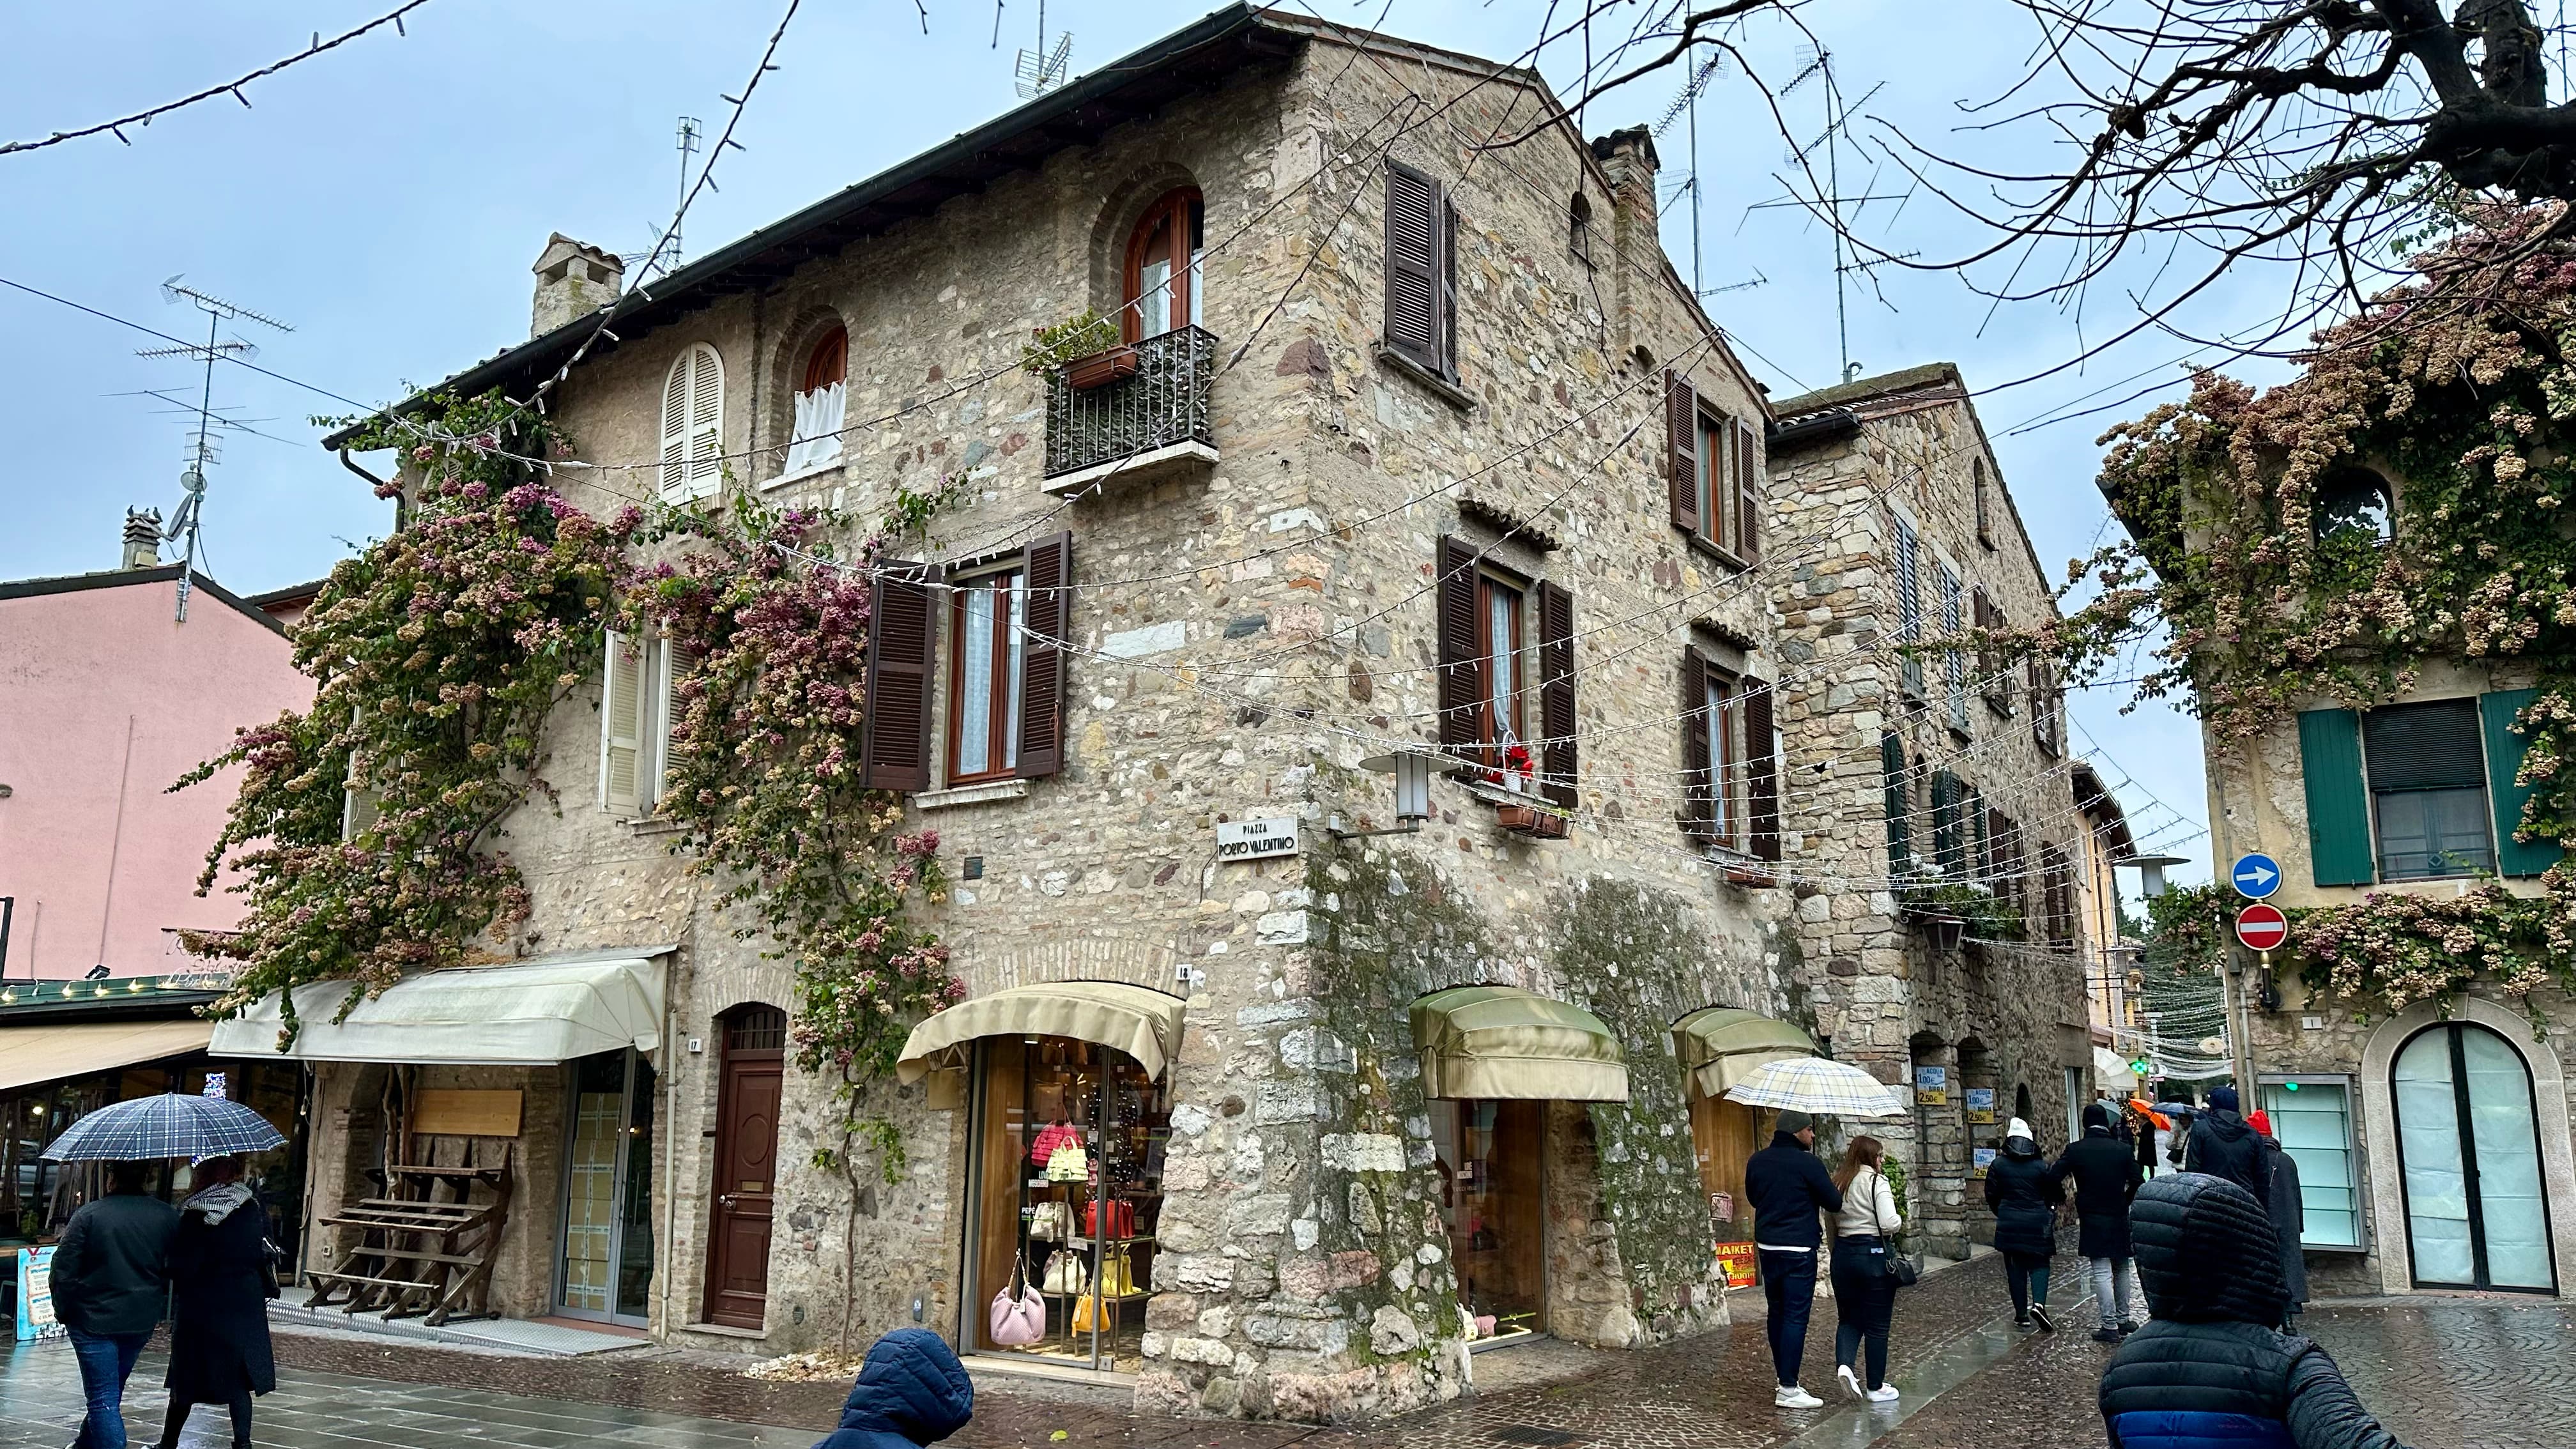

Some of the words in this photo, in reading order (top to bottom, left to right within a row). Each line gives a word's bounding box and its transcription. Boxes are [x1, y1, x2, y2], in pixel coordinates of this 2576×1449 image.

[1243, 823, 1268, 834] PIAZZA
[1219, 841, 1248, 856] PORTO
[1250, 836, 1294, 854] VALENTINO
[1180, 967, 1188, 978] 18
[691, 1041, 697, 1050] 17
